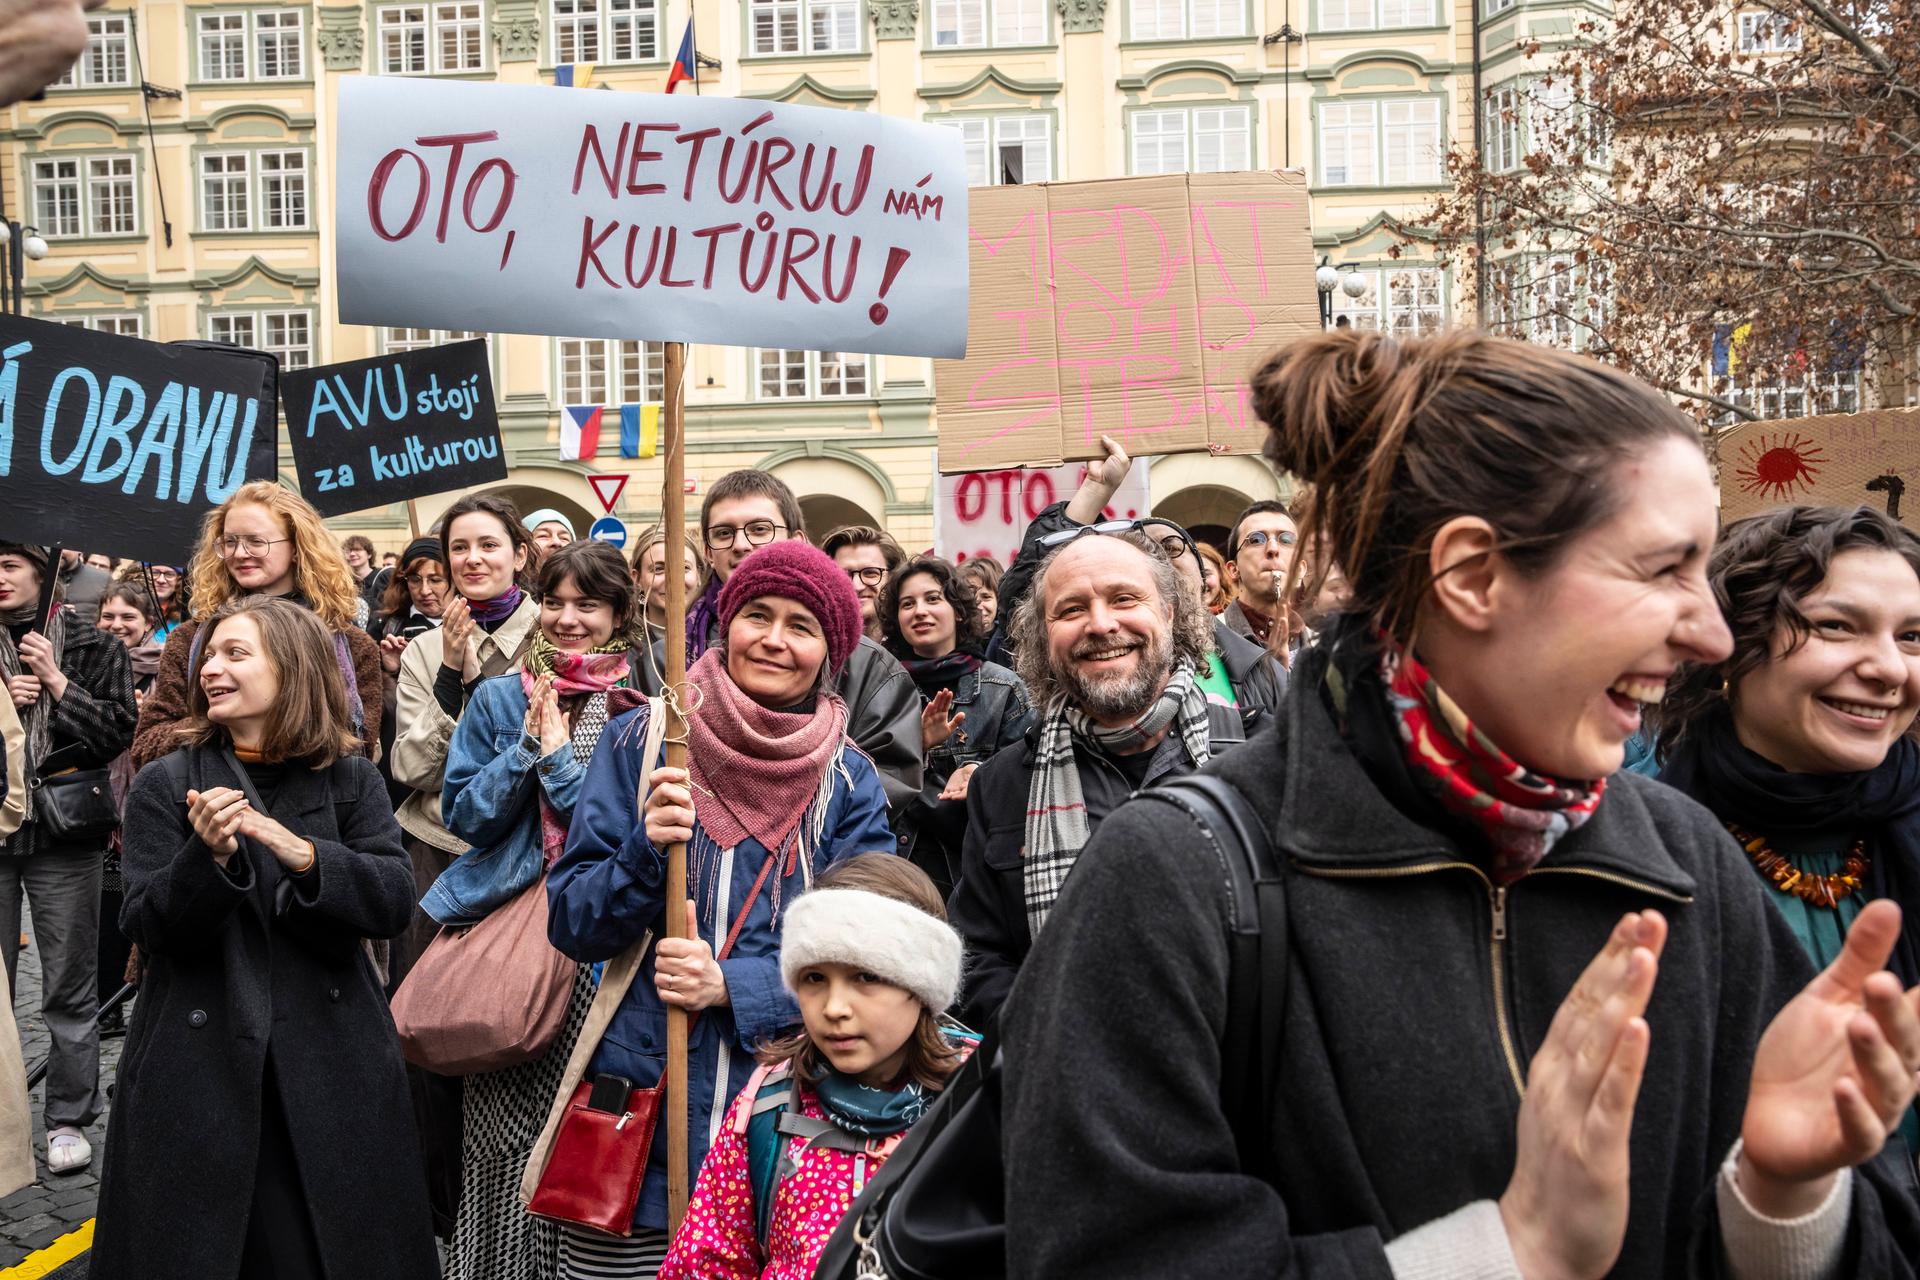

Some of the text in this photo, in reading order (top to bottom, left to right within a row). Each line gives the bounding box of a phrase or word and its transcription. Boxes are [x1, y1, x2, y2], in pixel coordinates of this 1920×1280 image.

[368, 110, 944, 272] OTO, NETÚRUJ NÁM
[992, 296, 1256, 358] TOHO
[306, 364, 481, 438] AVU stojí
[41, 366, 259, 505] OBAVU
[314, 434, 498, 493] za kulturou
[955, 470, 1056, 525] OTO
